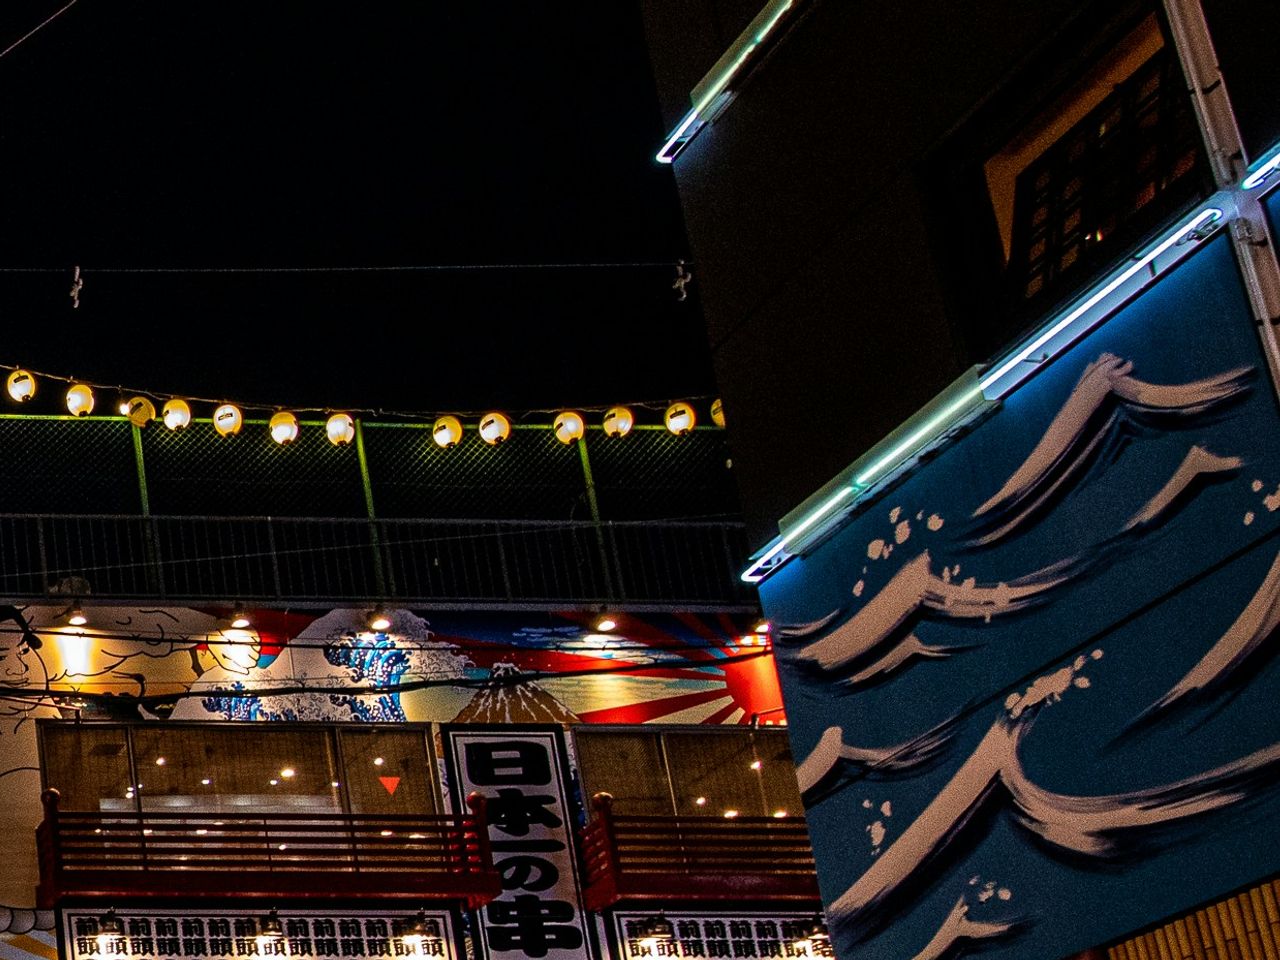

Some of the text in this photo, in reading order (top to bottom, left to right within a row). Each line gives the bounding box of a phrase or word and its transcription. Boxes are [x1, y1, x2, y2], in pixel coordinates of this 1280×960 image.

[104, 918, 128, 956] 頭
[263, 918, 287, 956] 頭
[656, 920, 680, 957] 頭
